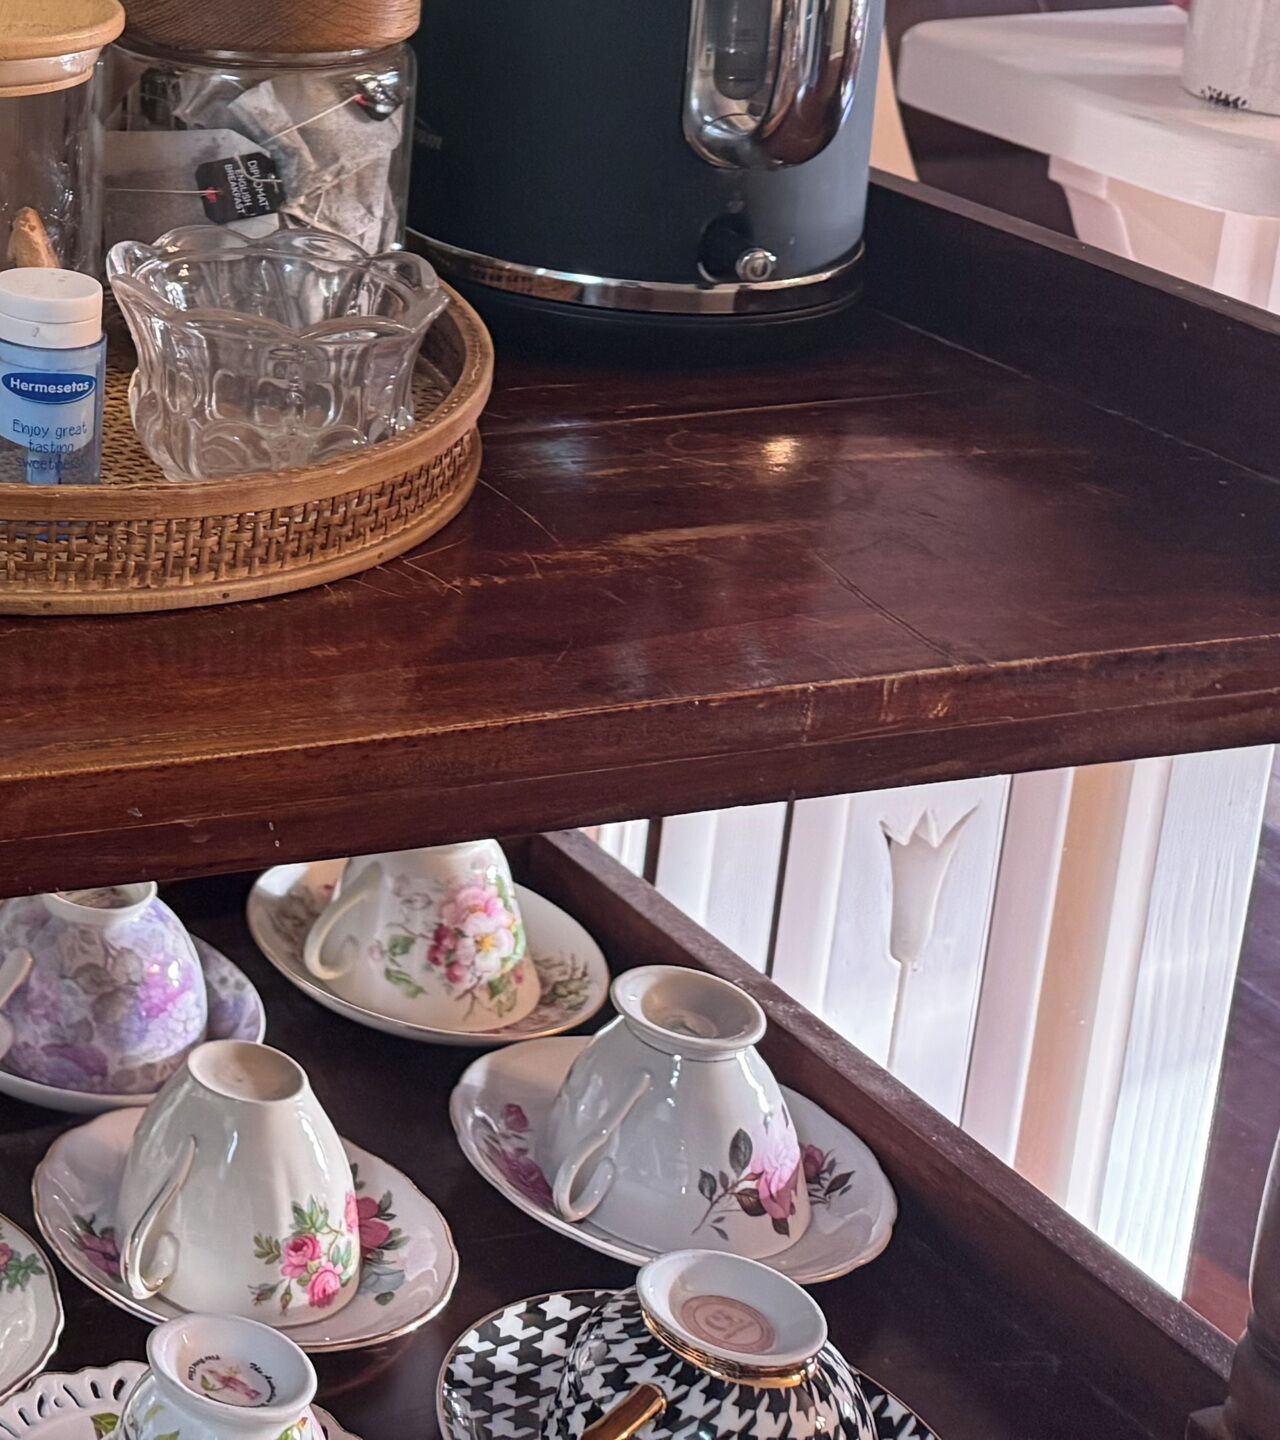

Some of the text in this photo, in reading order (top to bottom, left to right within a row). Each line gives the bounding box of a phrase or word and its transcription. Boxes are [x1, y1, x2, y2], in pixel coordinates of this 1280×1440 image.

[224, 163, 246, 215] BREAKFAST
[235, 168, 253, 207] ENGLISH
[10, 376, 90, 395] Hermesetas
[12, 418, 88, 440] Enjoy great
